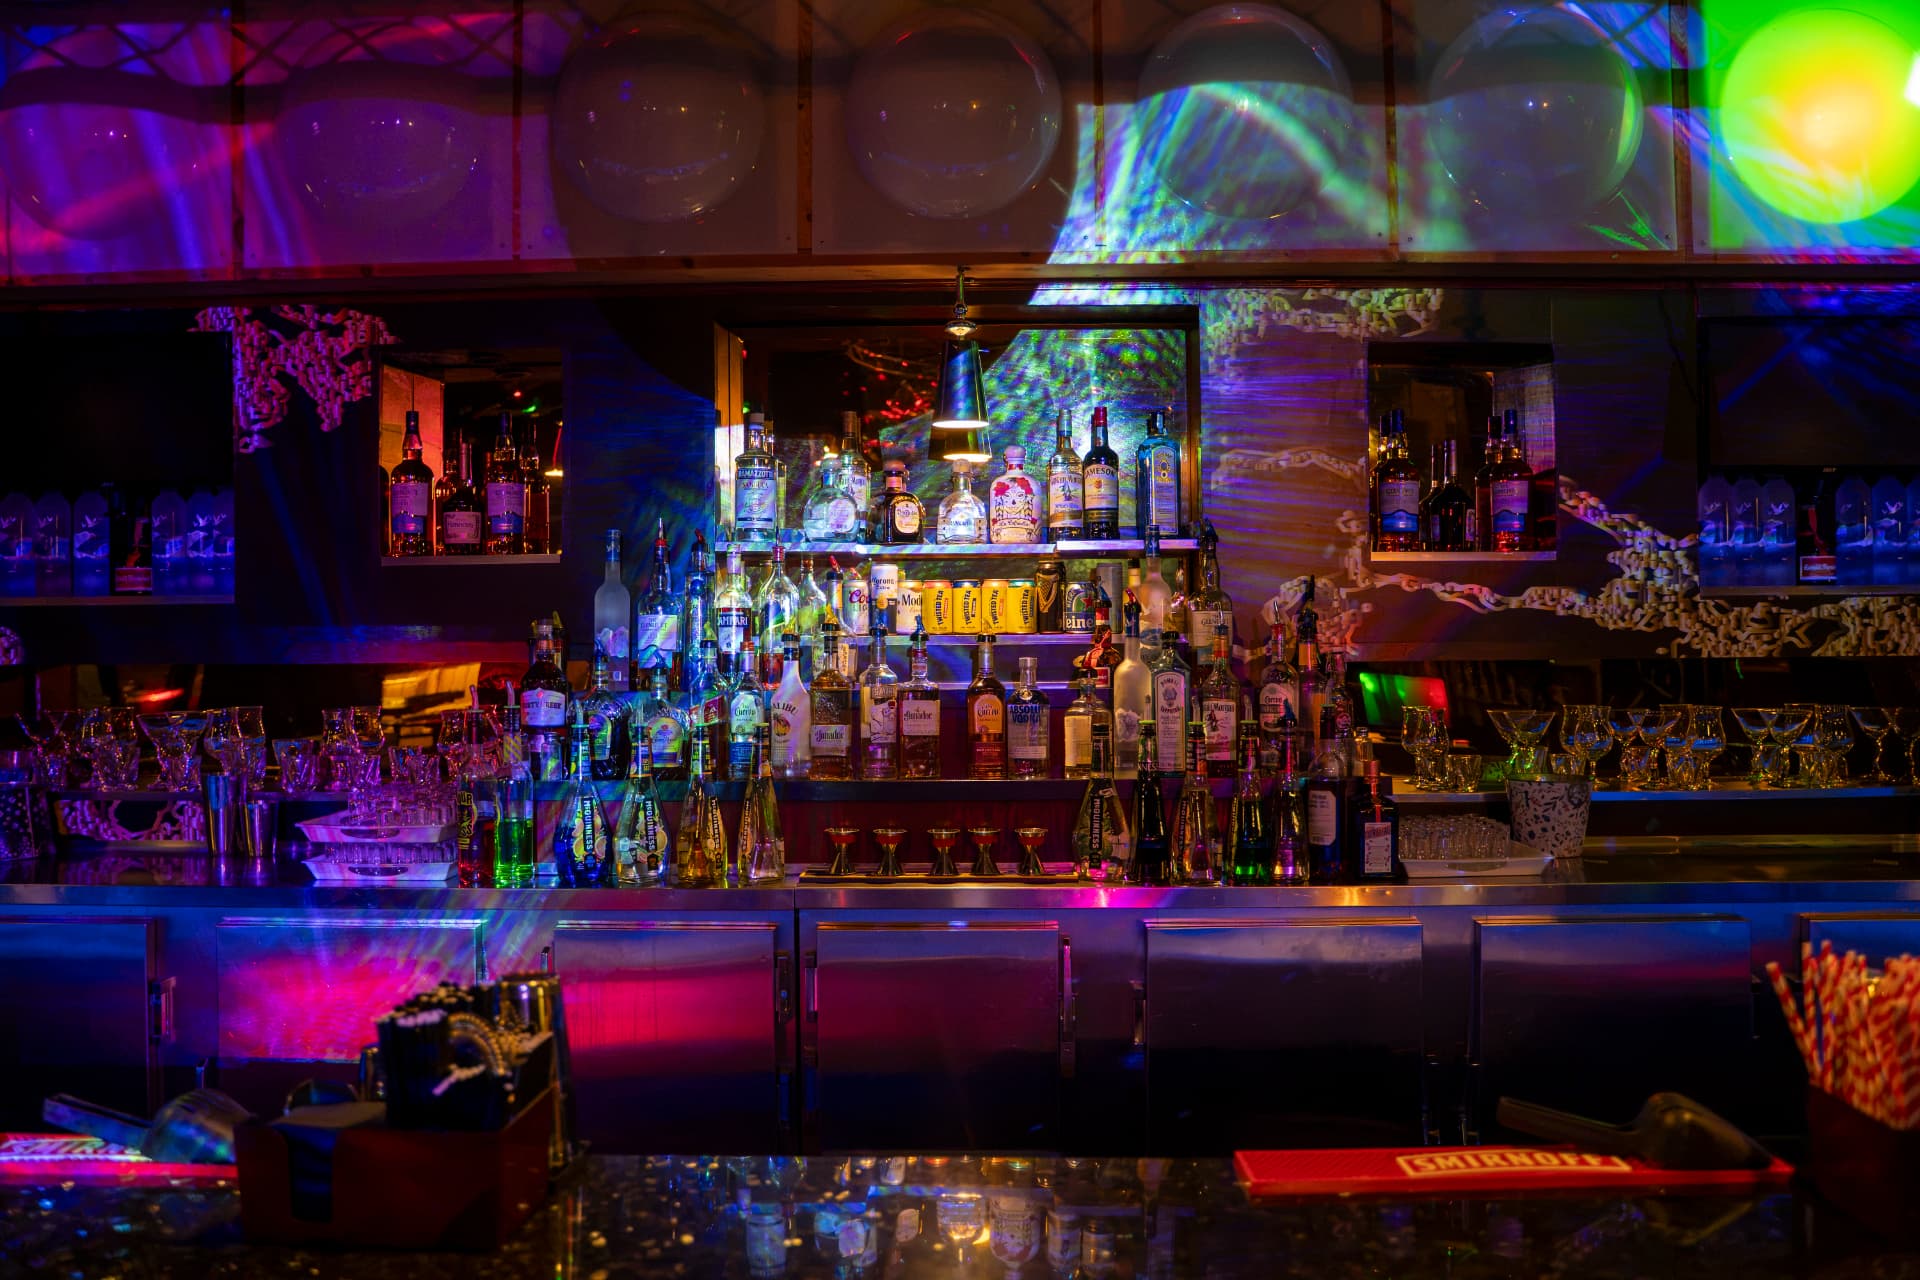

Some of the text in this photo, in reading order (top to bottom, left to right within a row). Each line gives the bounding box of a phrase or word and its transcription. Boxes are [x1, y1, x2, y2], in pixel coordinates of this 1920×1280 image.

[1084, 468, 1116, 479] JAMESON
[872, 577, 895, 586] Corona
[901, 594, 922, 606] Mod
[583, 800, 594, 850] McGUINNESS
[645, 800, 656, 851] McGUINNESS
[1092, 798, 1101, 849] McGUINNESS
[1413, 1152, 1603, 1171] SMIRNOFF
